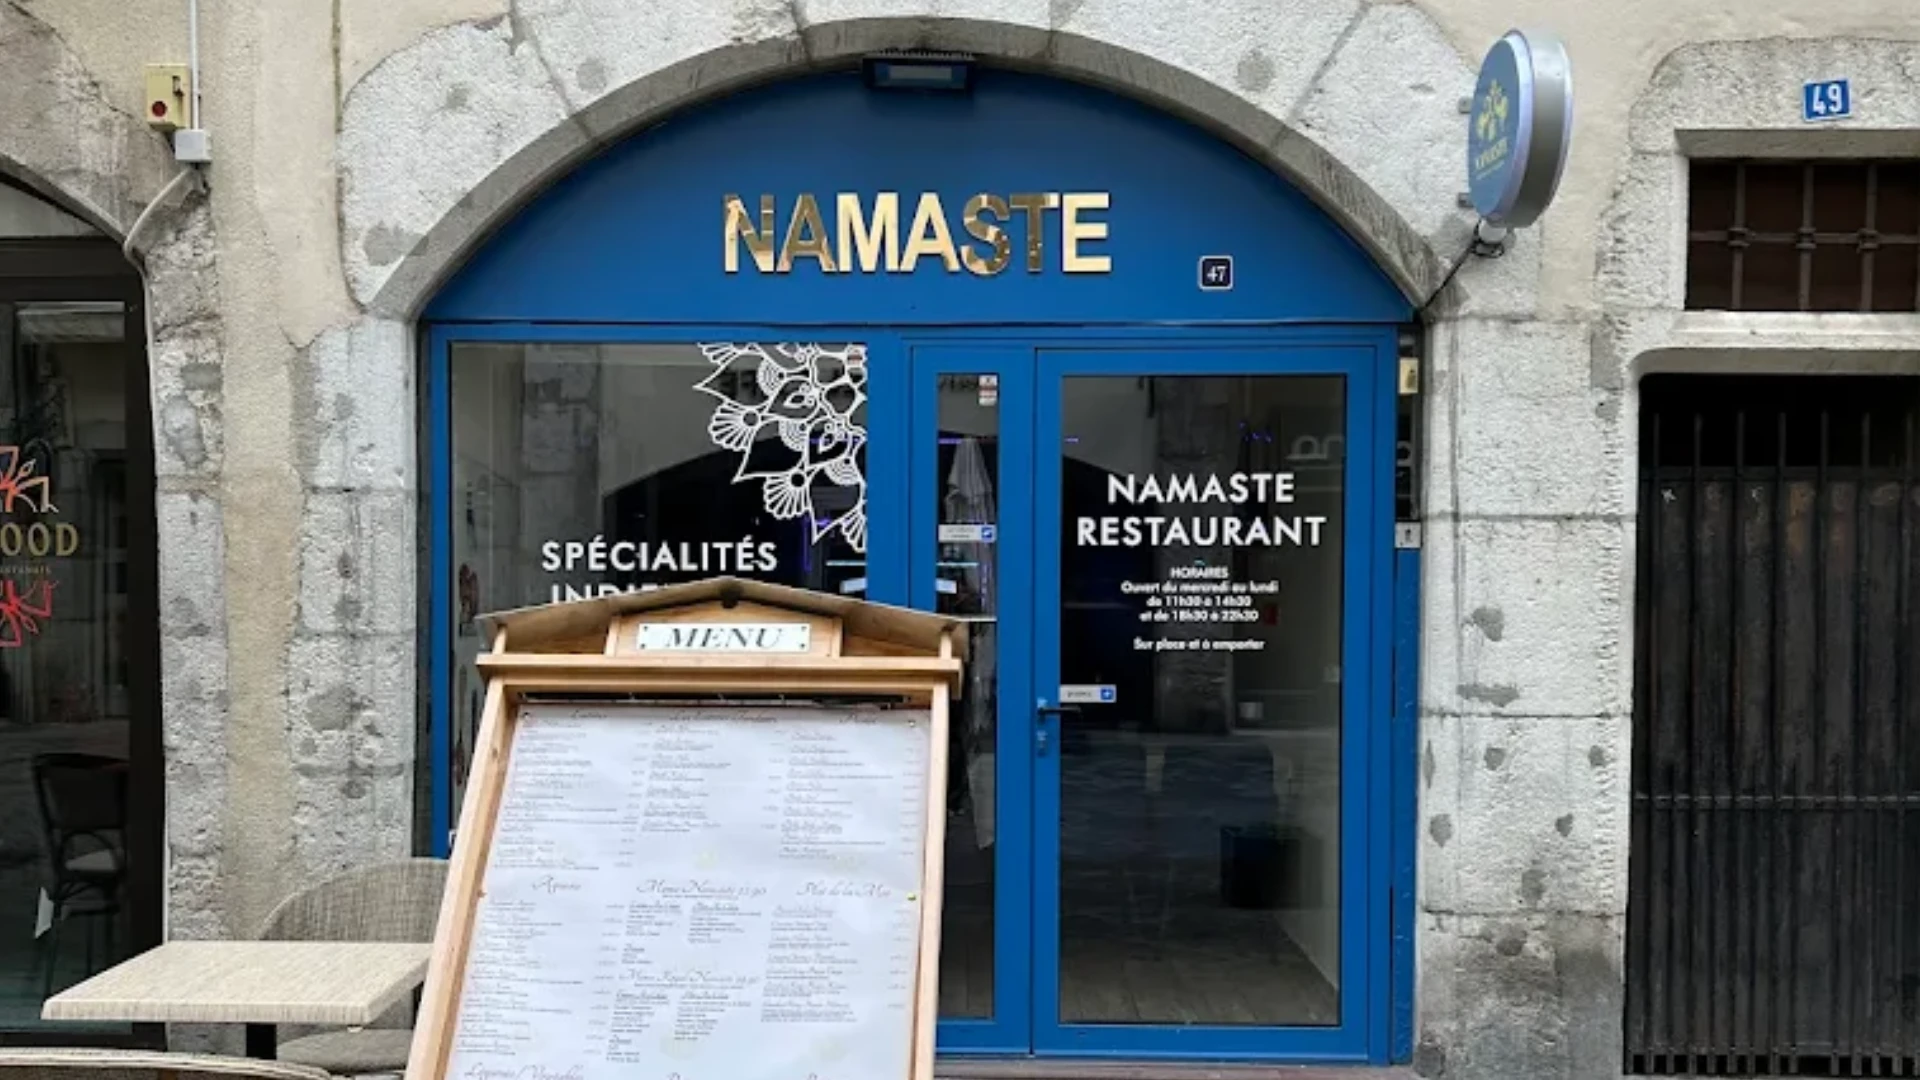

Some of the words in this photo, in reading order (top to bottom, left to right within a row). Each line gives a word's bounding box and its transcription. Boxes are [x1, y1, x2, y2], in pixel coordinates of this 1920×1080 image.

[1812, 84, 1842, 115] 49
[723, 192, 1112, 275] NAMASTE
[1206, 265, 1227, 282] 47
[1107, 473, 1294, 504] NAMASTE
[1076, 516, 1328, 547] RESTAURANT
[541, 534, 778, 572] SPÉCIALITÉS
[1170, 566, 1229, 579] HORAIRES
[1120, 580, 1160, 594] Ouvert
[1161, 580, 1178, 593] du
[1179, 580, 1230, 593] mercredi
[1231, 583, 1247, 593] au
[1249, 580, 1279, 593] lundi
[1146, 595, 1162, 607] de
[1165, 595, 1201, 607] 11h30
[1215, 595, 1252, 607] 14h30
[1139, 609, 1153, 622] et
[1153, 609, 1170, 622] de
[1221, 609, 1259, 622] 22h30
[664, 627, 784, 649] MENU
[1133, 637, 1154, 650] Sur
[1155, 637, 1186, 652] place
[1187, 638, 1200, 650] et
[1212, 638, 1266, 652] emporter
